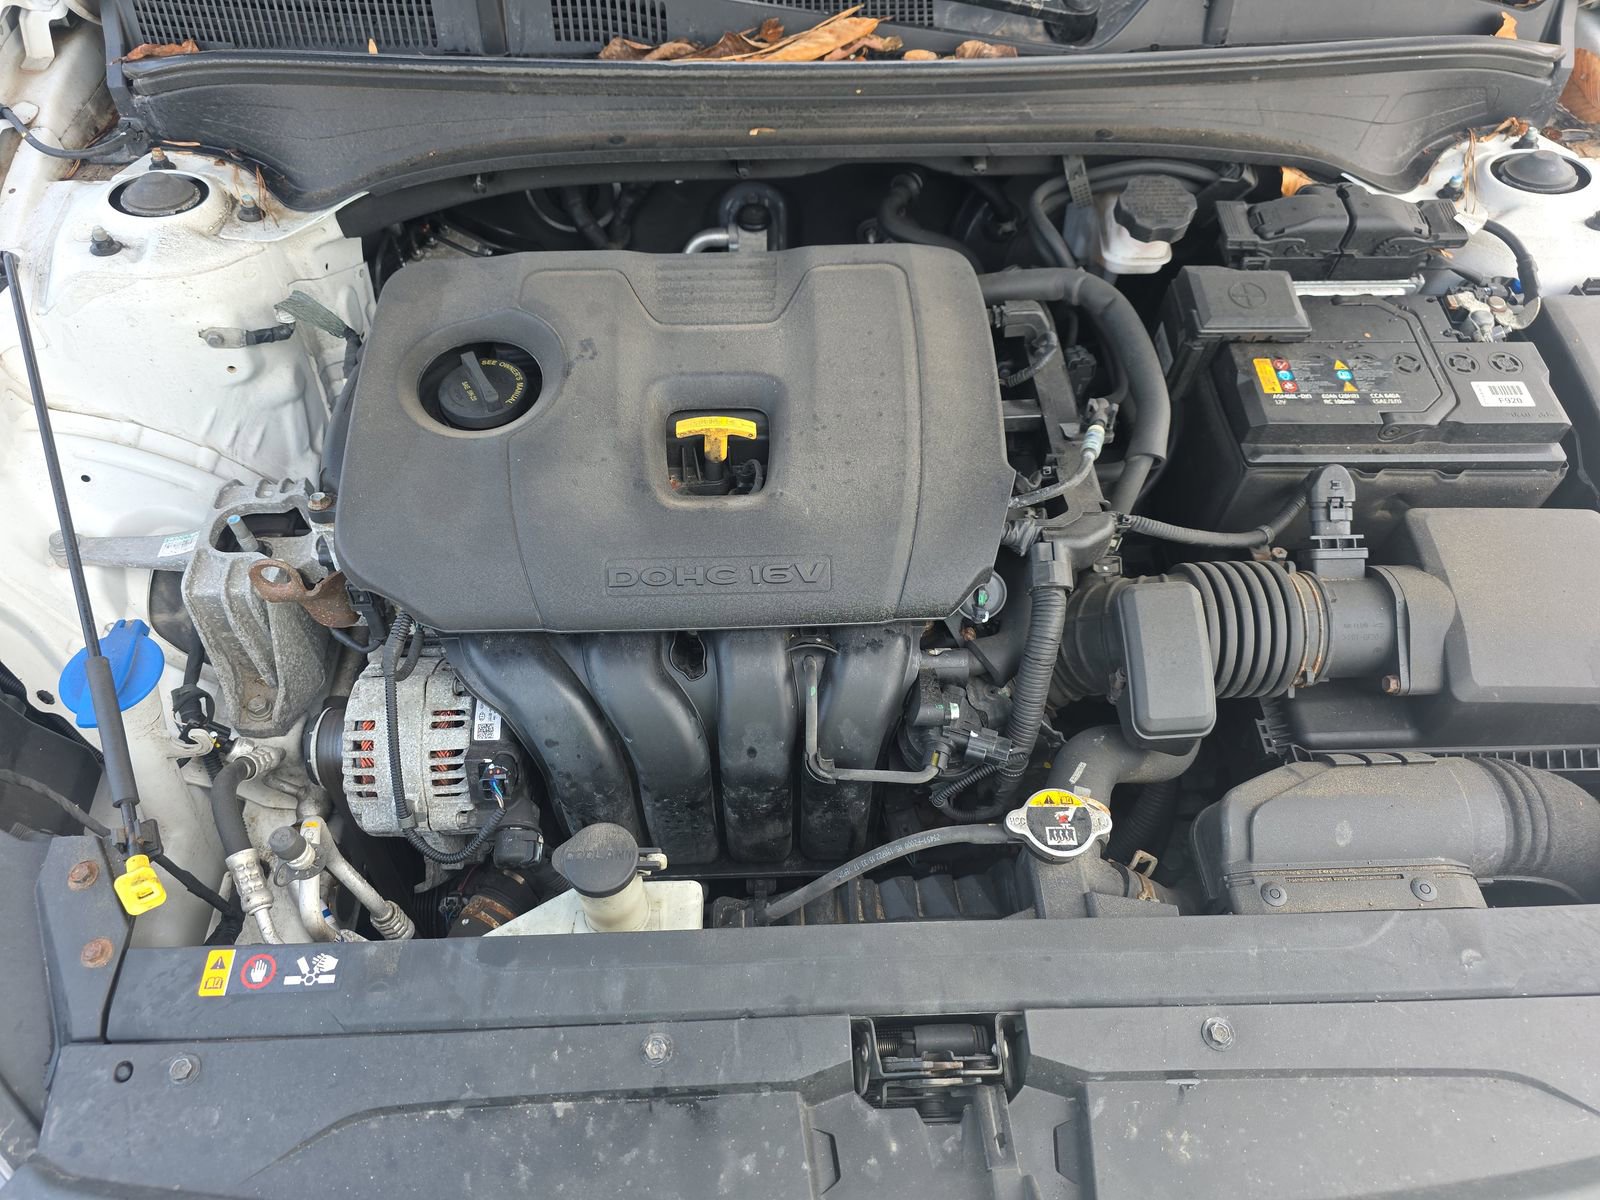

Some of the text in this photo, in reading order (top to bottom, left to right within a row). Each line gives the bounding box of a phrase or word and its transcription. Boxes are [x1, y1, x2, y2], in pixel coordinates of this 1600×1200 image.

[481, 359, 524, 404] SEE OWNER'S MANUAL
[607, 562, 825, 588] DOHC 16V
